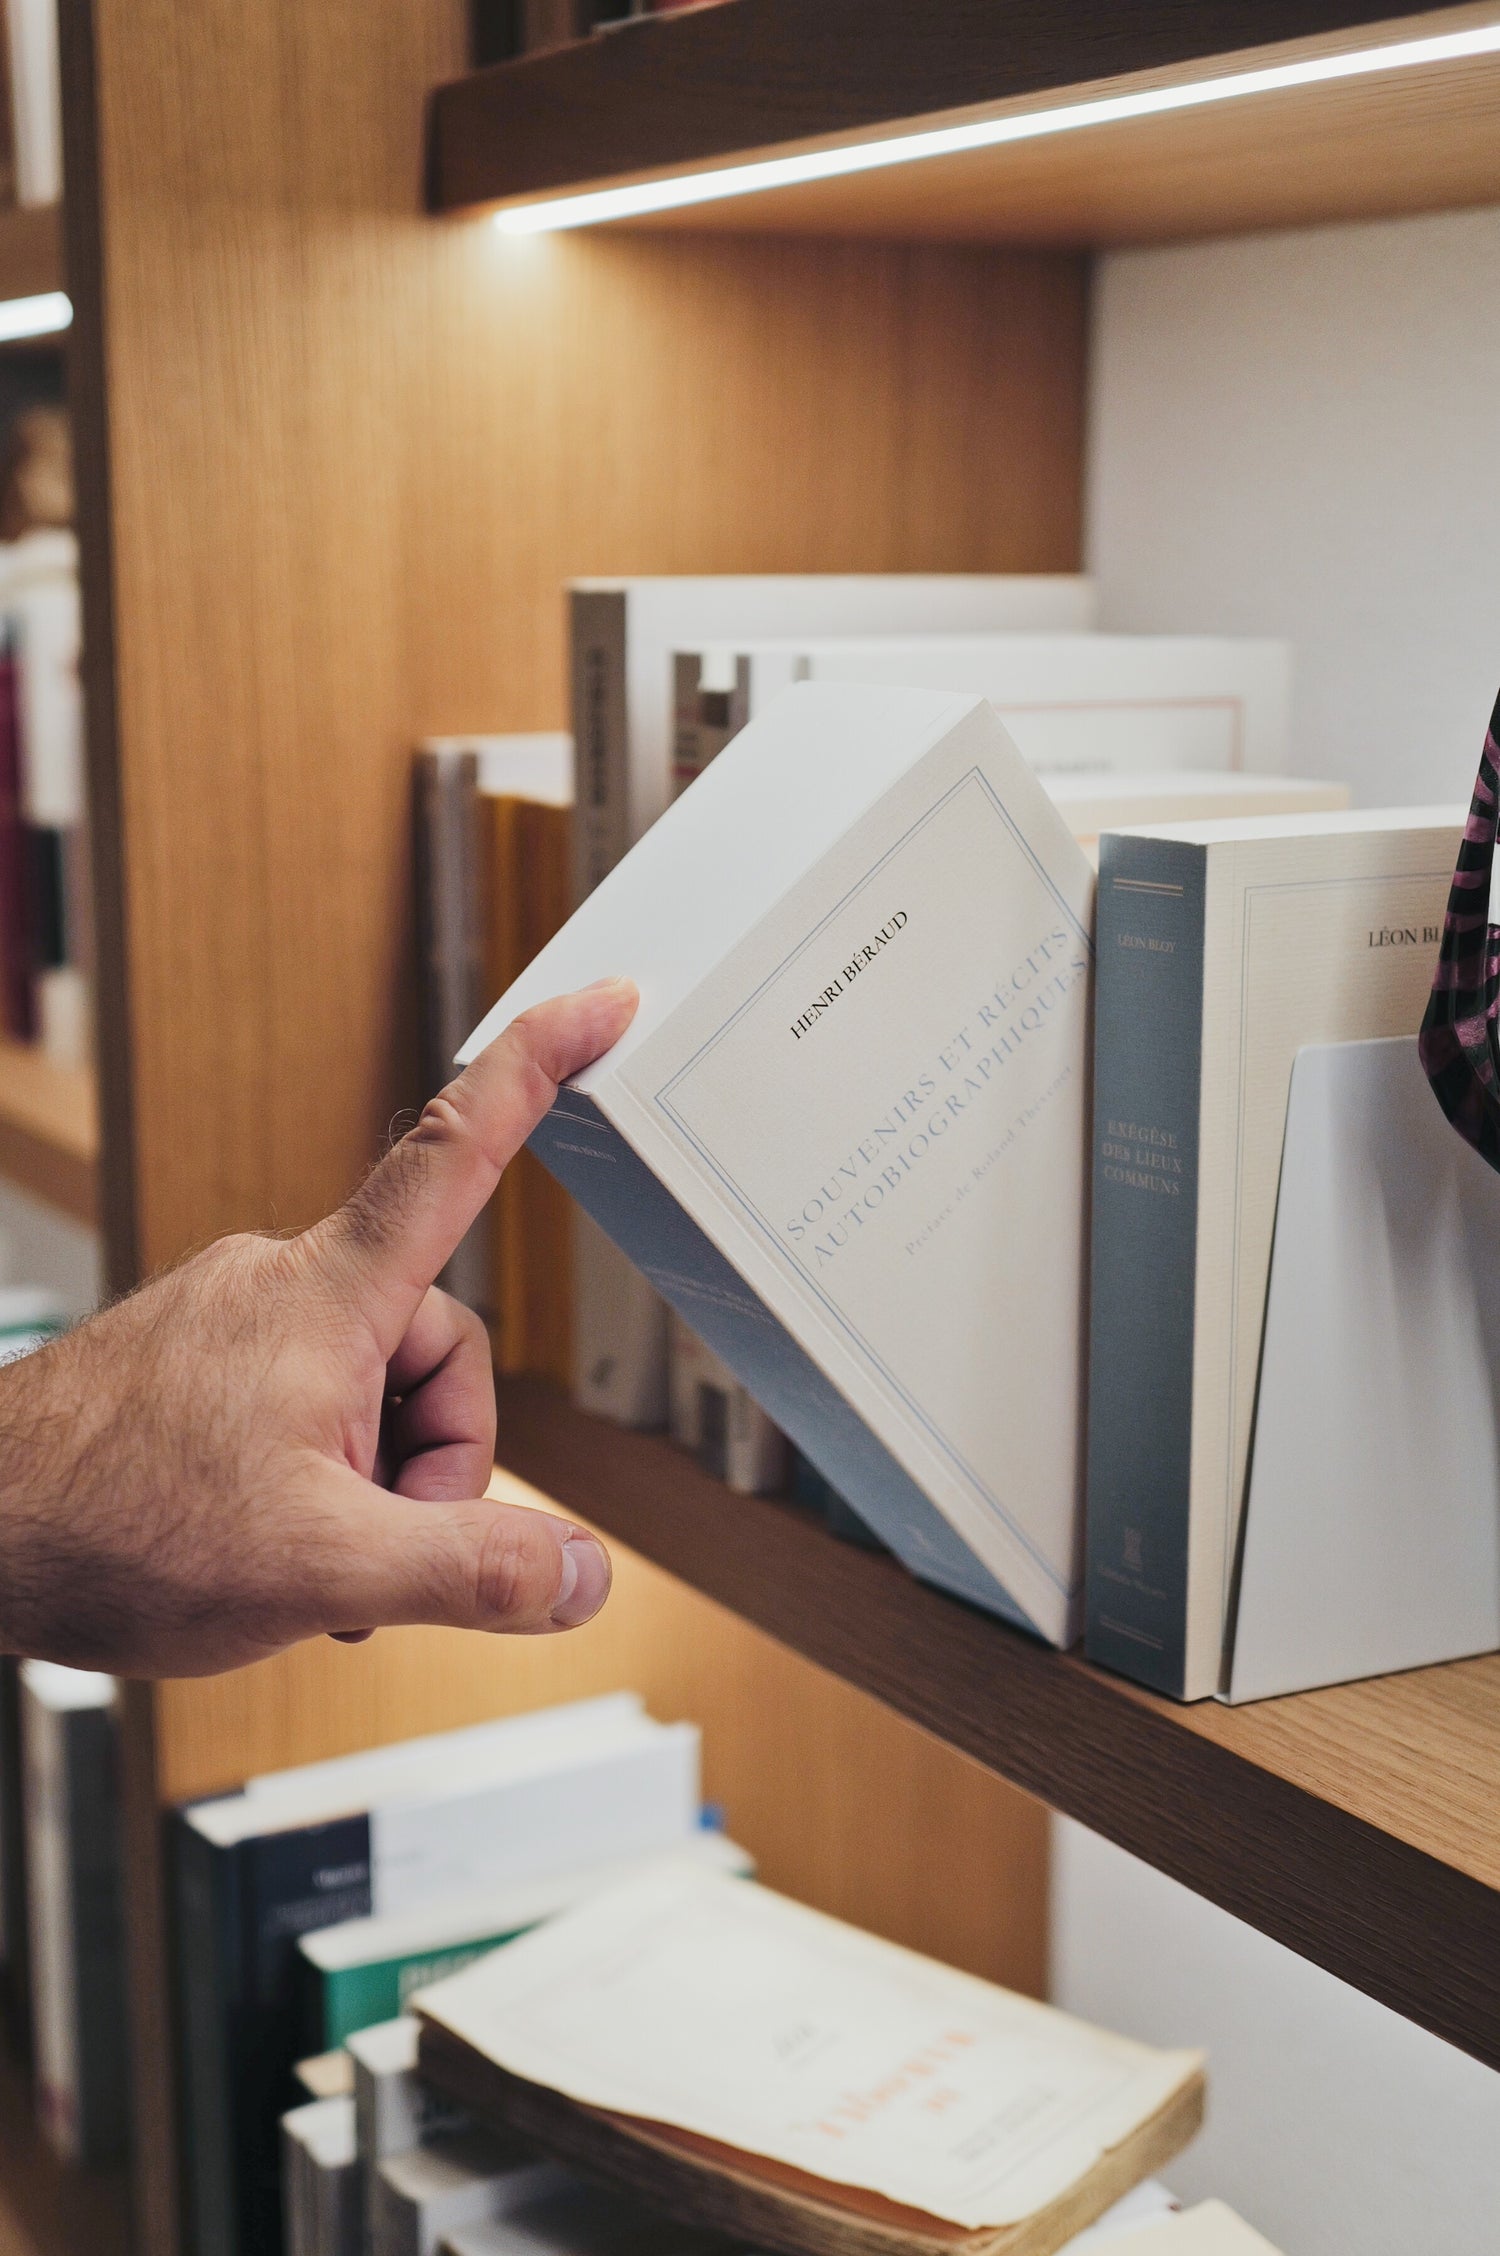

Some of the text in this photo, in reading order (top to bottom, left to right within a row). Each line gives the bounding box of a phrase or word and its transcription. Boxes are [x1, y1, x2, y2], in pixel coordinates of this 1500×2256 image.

[1148, 938, 1177, 954] BLOY
[1368, 926, 1418, 948] LÉON
[790, 911, 908, 1040] HENRI BÉRAUD
[786, 925, 1068, 1241] SOUVENIRS ET RÉCITS
[813, 953, 1087, 1268] AUTOBIOGRAPHIQUES
[1102, 1142, 1183, 1174] DES LIEUX
[1103, 1166, 1180, 1195] COMMUNS
